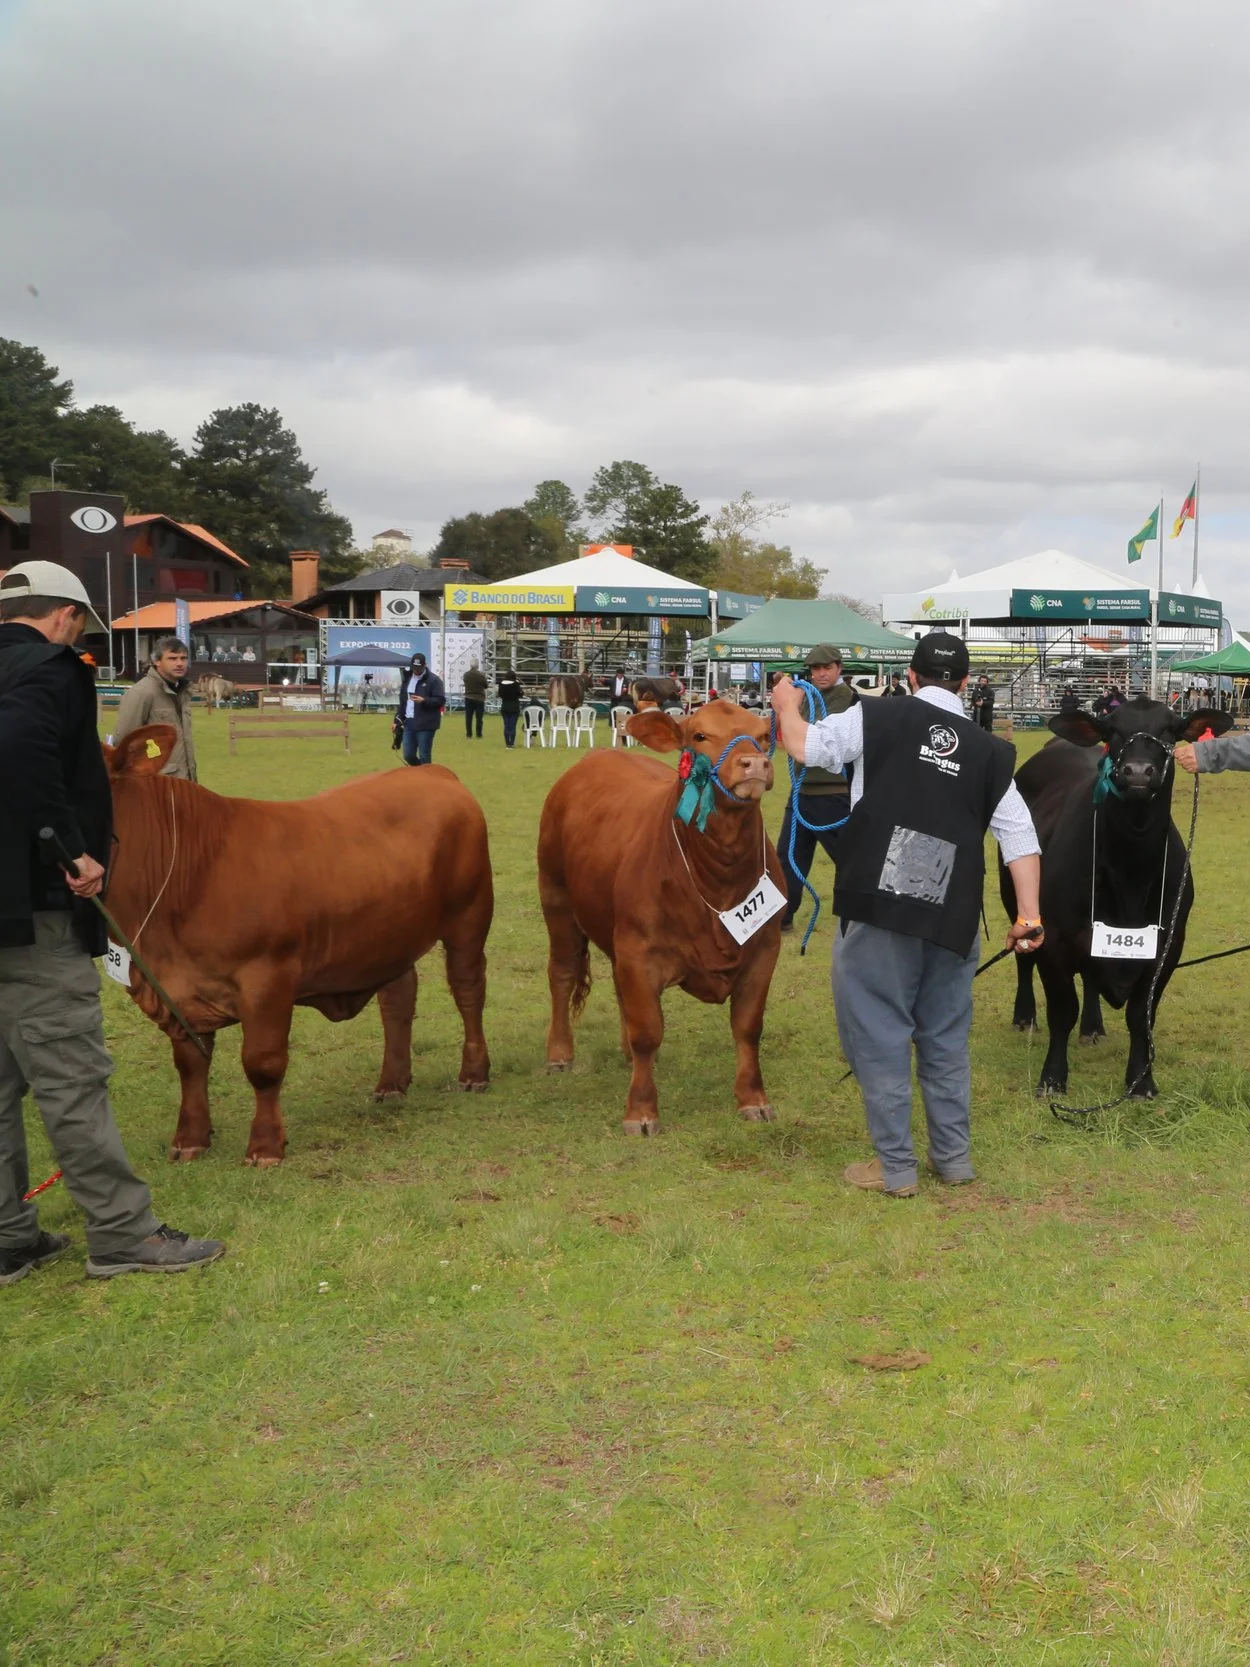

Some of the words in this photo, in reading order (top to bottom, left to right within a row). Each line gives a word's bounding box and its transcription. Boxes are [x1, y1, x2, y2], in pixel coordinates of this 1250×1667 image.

[471, 591, 510, 604] BANCO
[511, 593, 526, 604] DO
[527, 592, 566, 605] BRASIL
[611, 596, 627, 604] CNA
[1046, 599, 1063, 607] CNA
[929, 607, 968, 619] Cotribá
[390, 641, 412, 649] 2022
[920, 744, 961, 771] Brngus
[735, 890, 765, 923] 1477
[1105, 933, 1145, 948] 1484
[108, 948, 121, 967] 58
